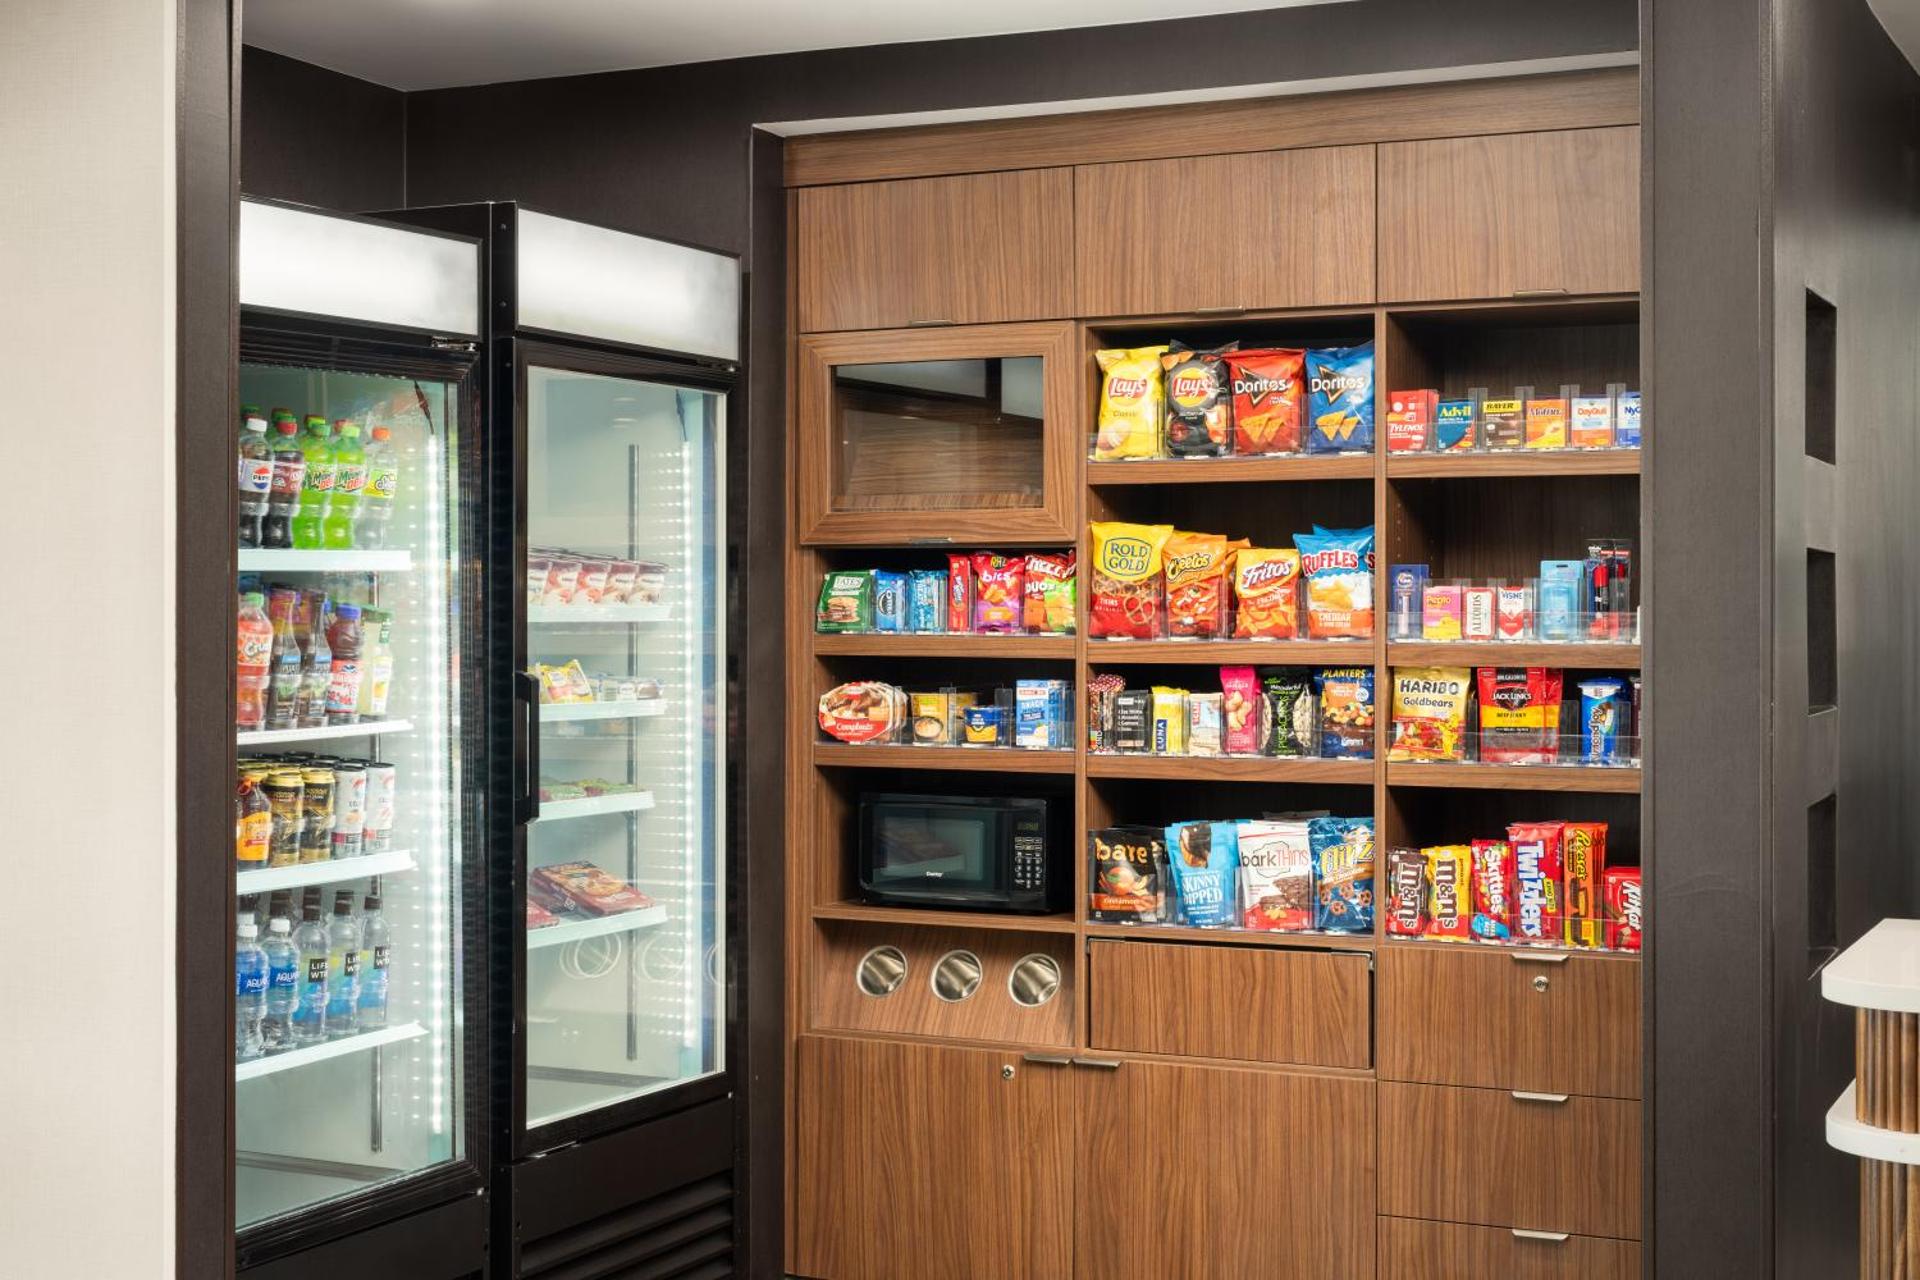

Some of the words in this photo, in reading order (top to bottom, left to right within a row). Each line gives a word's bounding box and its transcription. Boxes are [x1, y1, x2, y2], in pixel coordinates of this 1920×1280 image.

[1109, 377, 1147, 399] Lay's
[1174, 377, 1214, 400] Lay's
[1234, 379, 1286, 395] Doritos
[1311, 376, 1365, 393] Doritos
[1440, 405, 1472, 417] Advil
[1577, 407, 1607, 418] DayQuil
[1390, 424, 1424, 433] TYLENOL
[1110, 543, 1148, 558] ROLD
[1109, 557, 1145, 571] GOLD
[1167, 553, 1211, 581] Cheetos
[1302, 550, 1358, 577] RUFFLES
[1242, 560, 1294, 588] Fritos
[1502, 592, 1523, 600] VISINE
[1472, 594, 1482, 633] ALTOIDS
[1322, 669, 1367, 679] PLANTERS
[1399, 679, 1460, 695] HARIBO
[1403, 696, 1454, 708] Goldbears
[1157, 721, 1166, 751] LUNA
[1095, 837, 1148, 864] bare
[1575, 829, 1592, 881] Reese's
[1484, 847, 1505, 914] Skittles
[1517, 840, 1547, 937] Twizzlers
